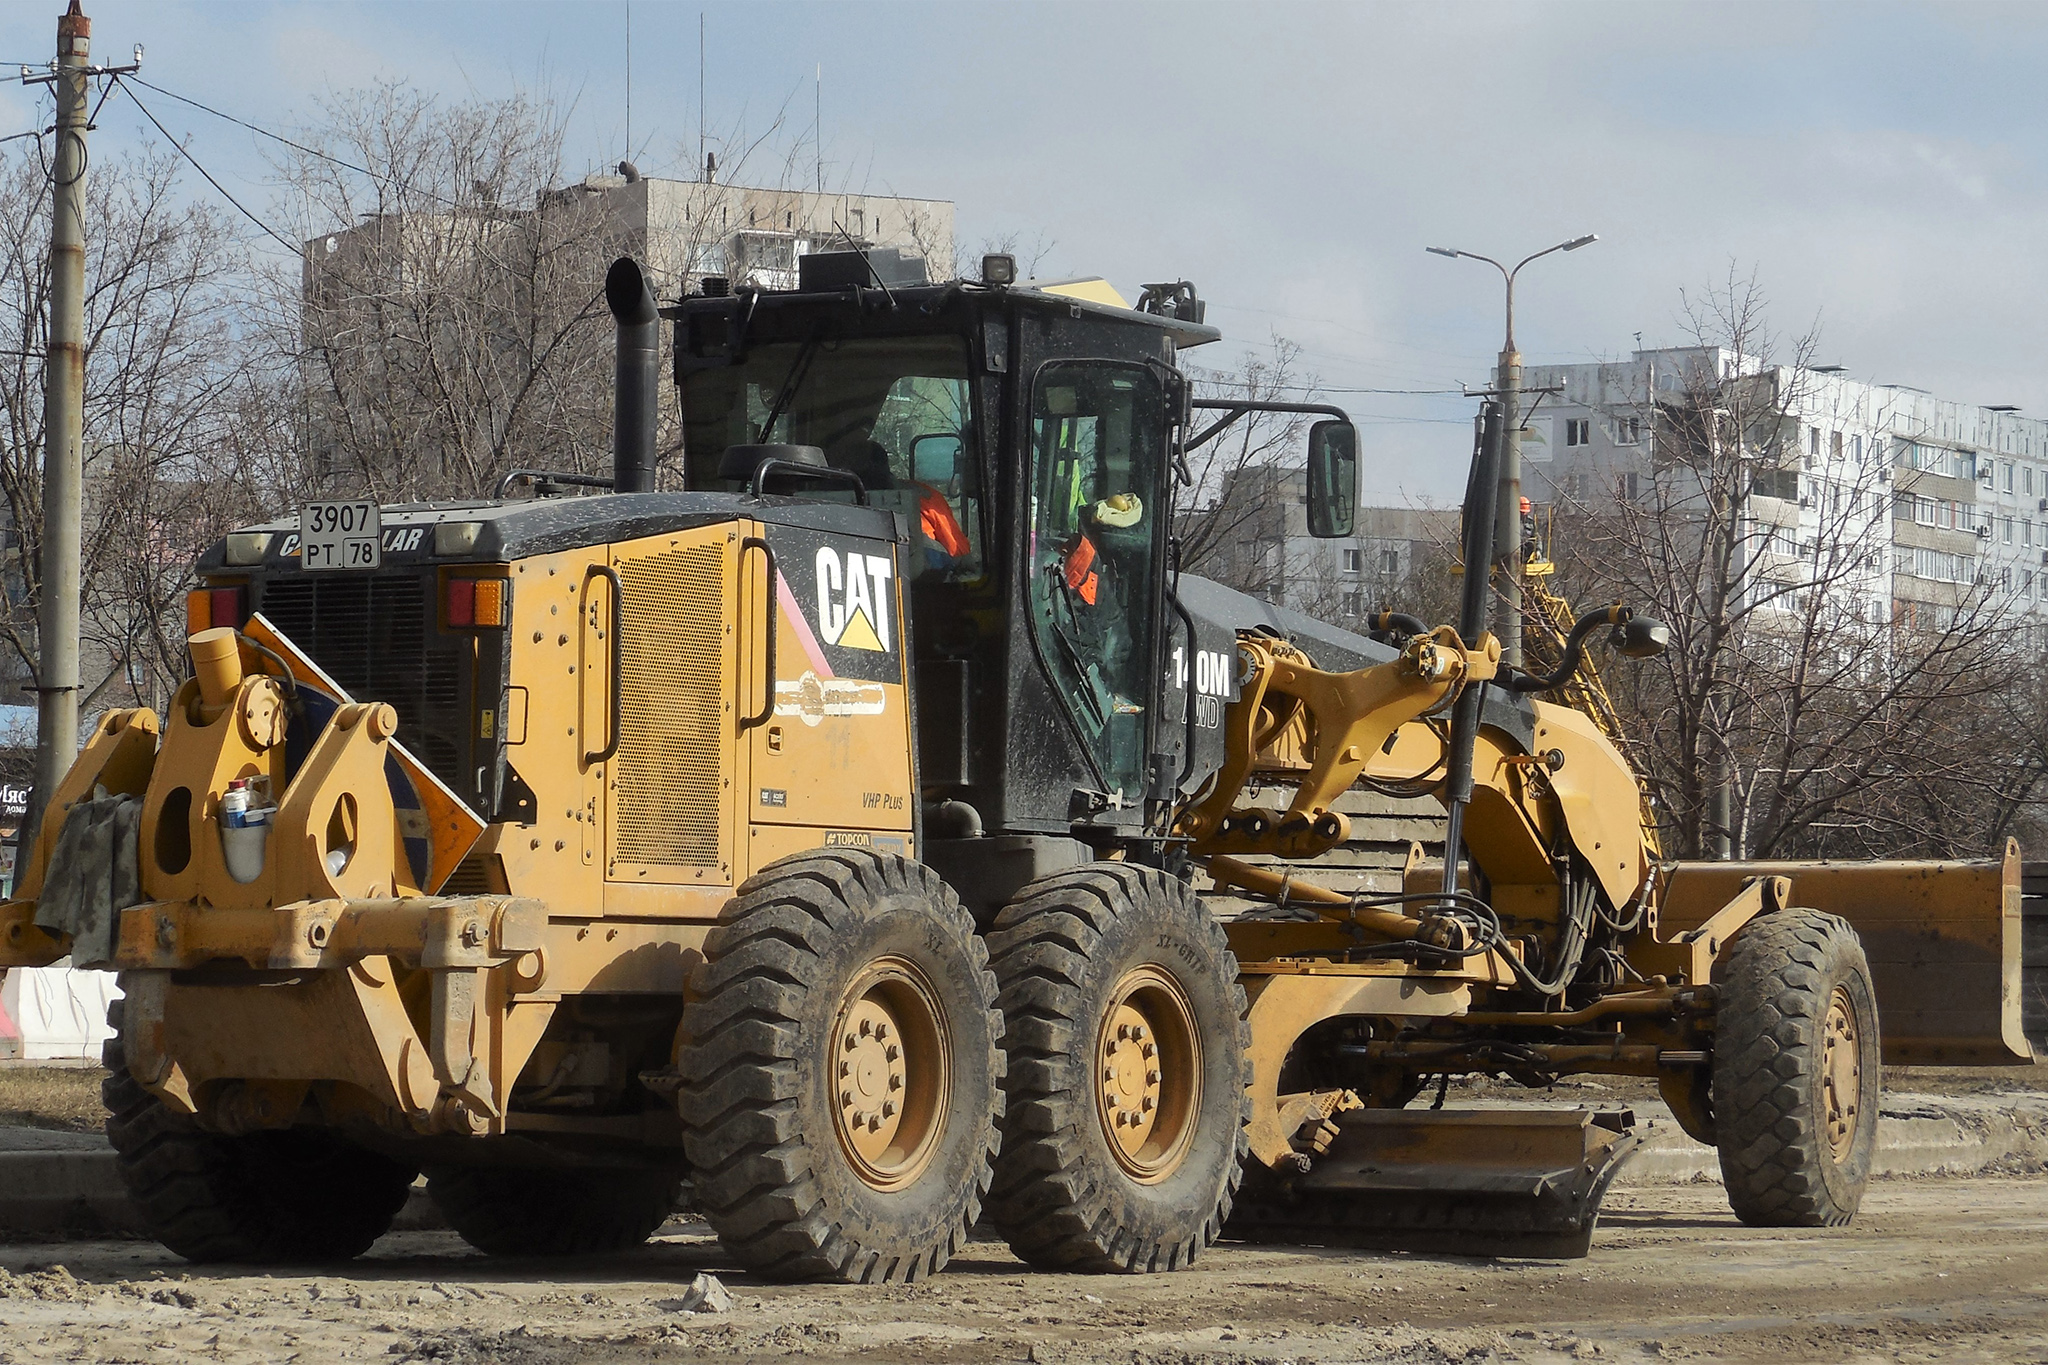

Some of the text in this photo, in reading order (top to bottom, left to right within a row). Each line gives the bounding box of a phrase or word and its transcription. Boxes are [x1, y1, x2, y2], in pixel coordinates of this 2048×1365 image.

[310, 505, 369, 533] 3907
[350, 543, 373, 565] 78
[815, 546, 891, 653] CAT
[862, 792, 882, 808] VHP
[836, 833, 870, 846] TOPCON
